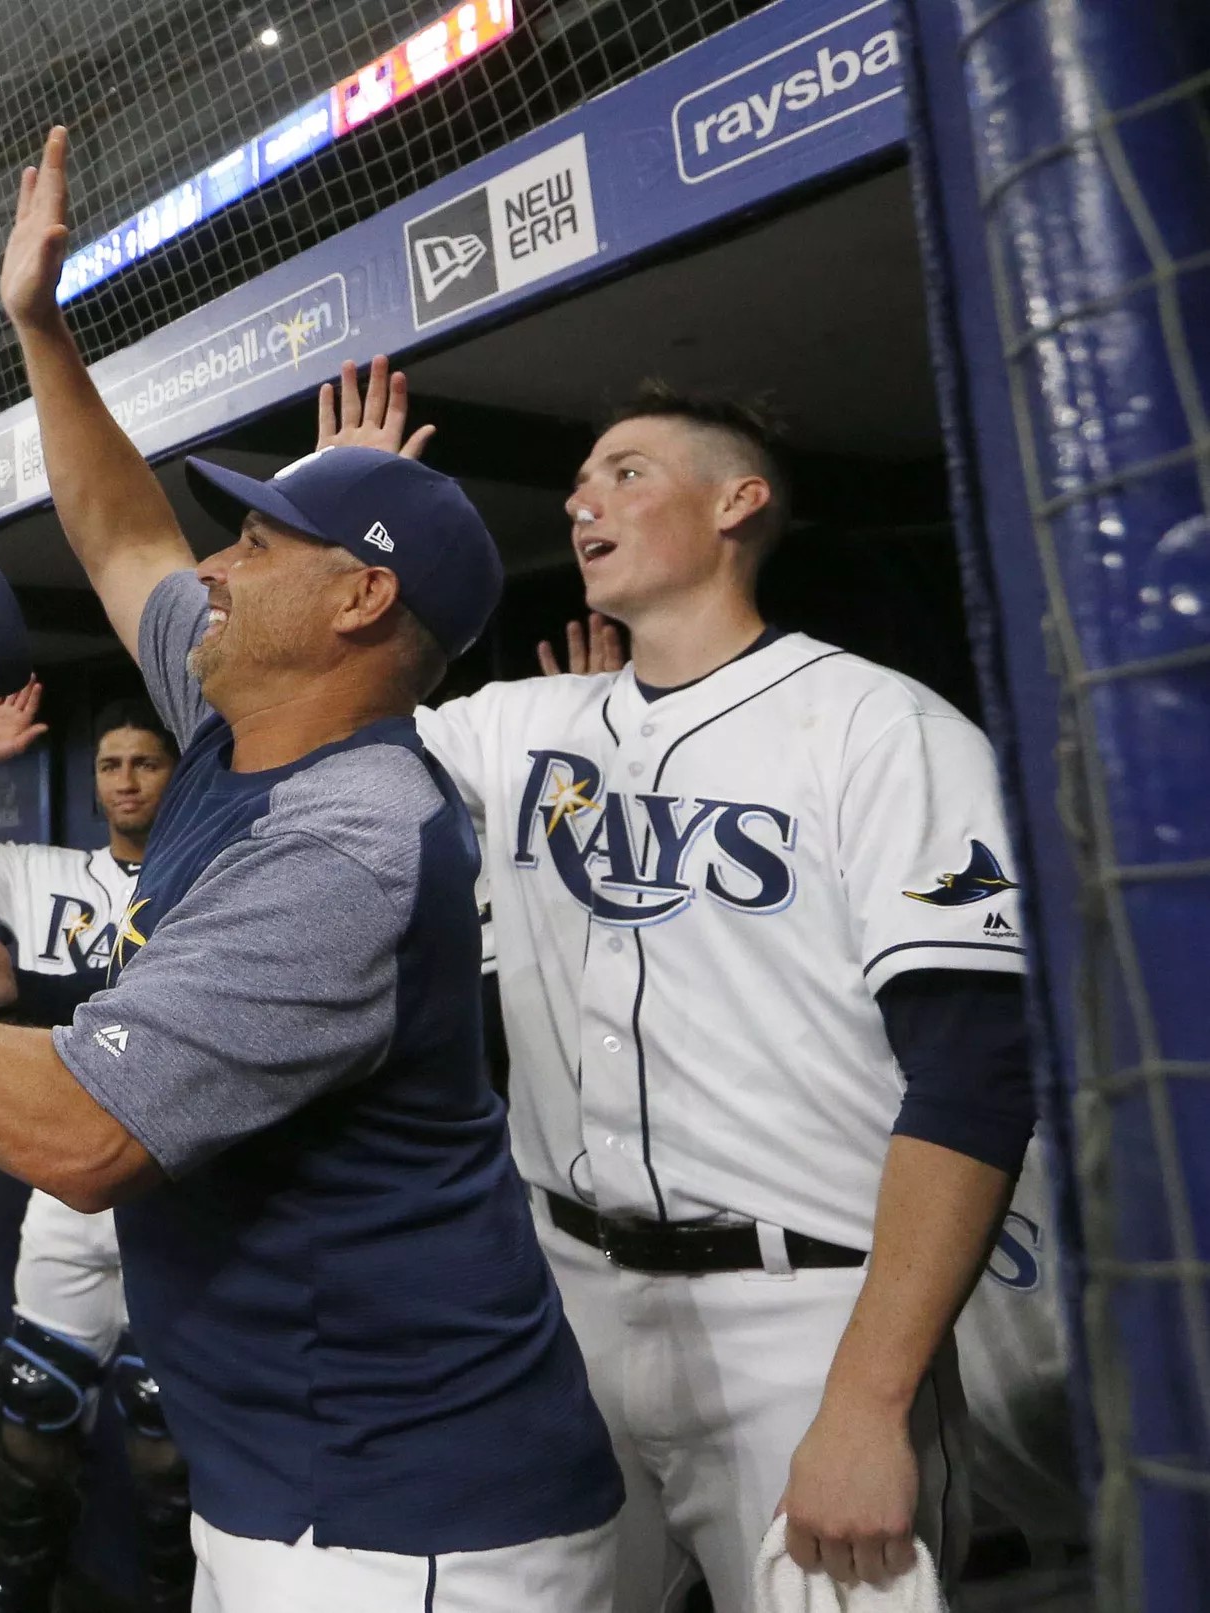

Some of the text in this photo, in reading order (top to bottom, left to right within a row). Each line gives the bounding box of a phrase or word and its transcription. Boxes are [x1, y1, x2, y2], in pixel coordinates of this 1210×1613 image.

[694, 30, 900, 155] raysba
[505, 168, 573, 229] NEW
[510, 204, 578, 260] ERA
[515, 749, 797, 928] RAYS
